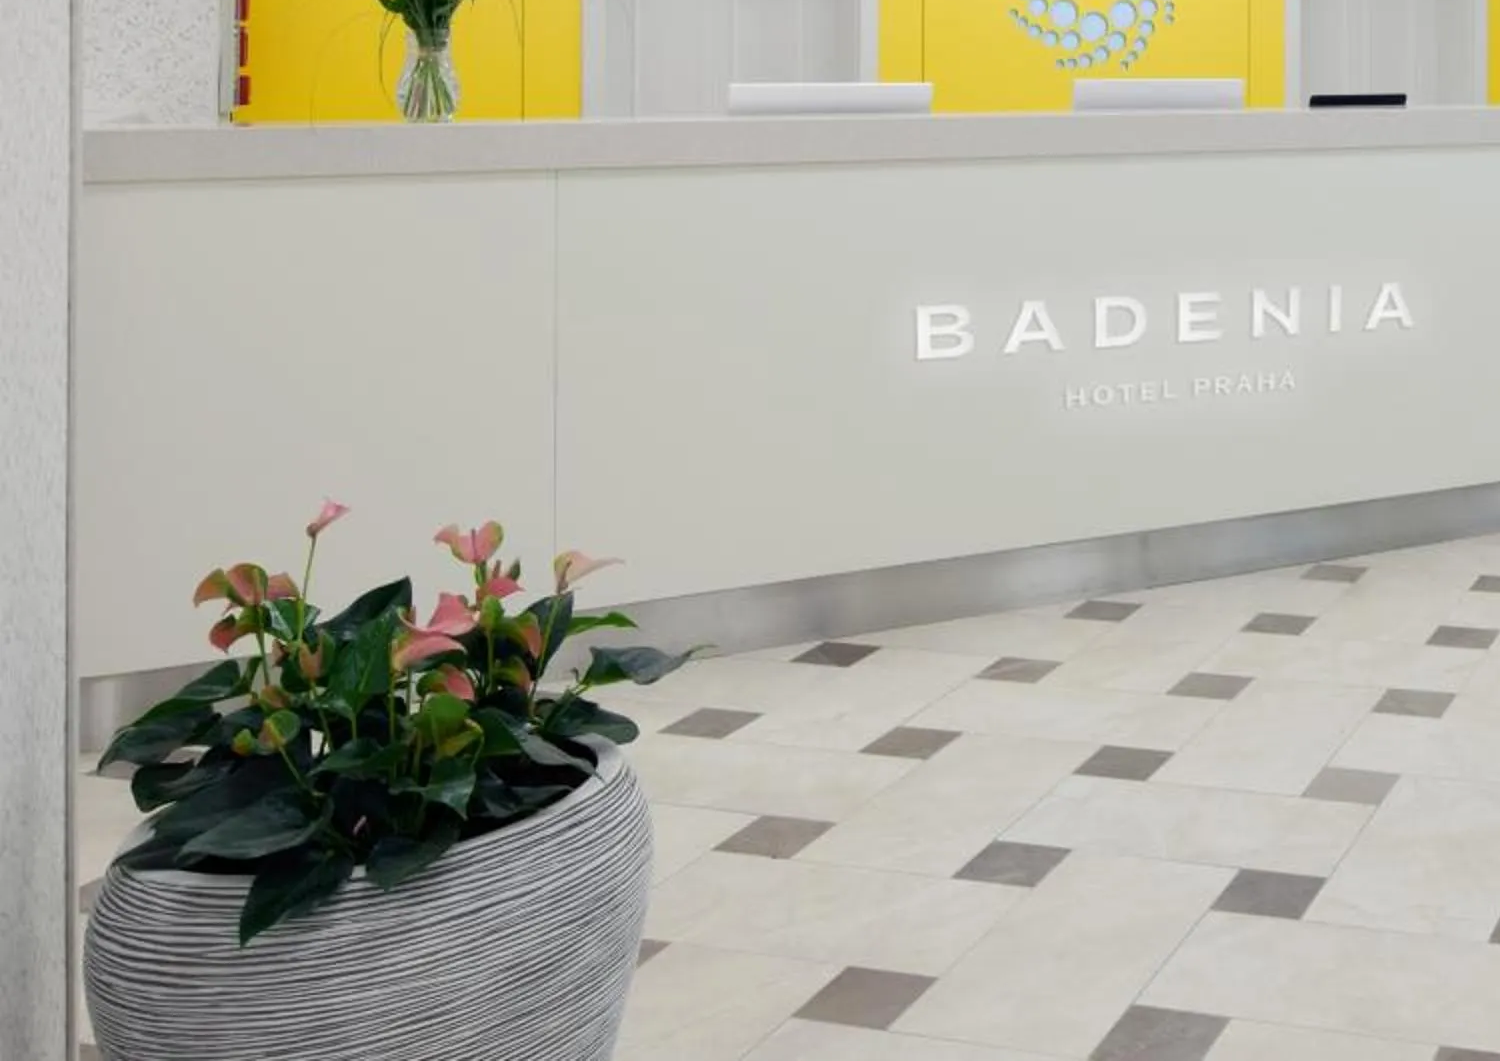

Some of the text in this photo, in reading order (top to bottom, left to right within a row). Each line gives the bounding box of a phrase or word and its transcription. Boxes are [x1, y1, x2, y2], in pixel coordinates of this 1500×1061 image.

[915, 281, 1415, 360] BADENIA
[1065, 370, 1296, 408] HOTEL PRAHA
